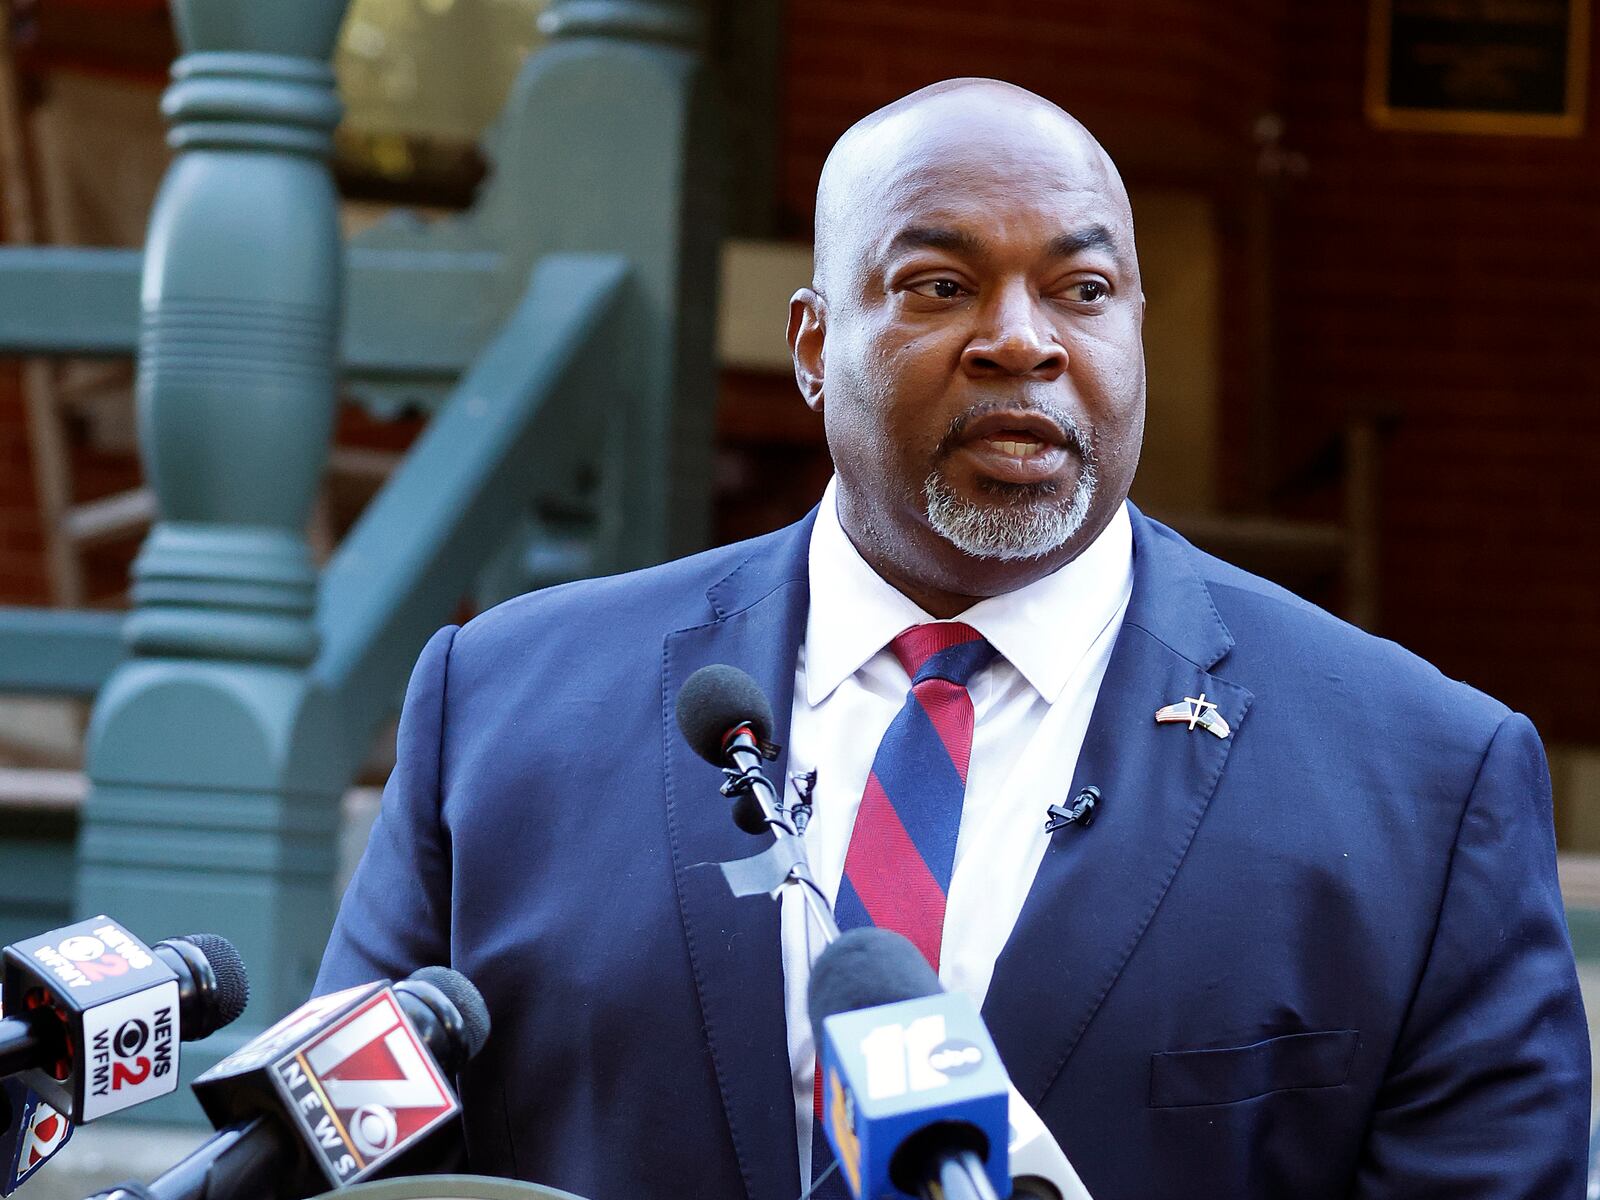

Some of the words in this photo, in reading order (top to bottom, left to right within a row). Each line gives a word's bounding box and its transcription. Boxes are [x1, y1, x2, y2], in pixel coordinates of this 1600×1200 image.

[92, 1028, 109, 1097] WFMY
[112, 1056, 151, 1091] 2
[152, 1006, 172, 1078] NEWS
[282, 1062, 356, 1177] NEWS
